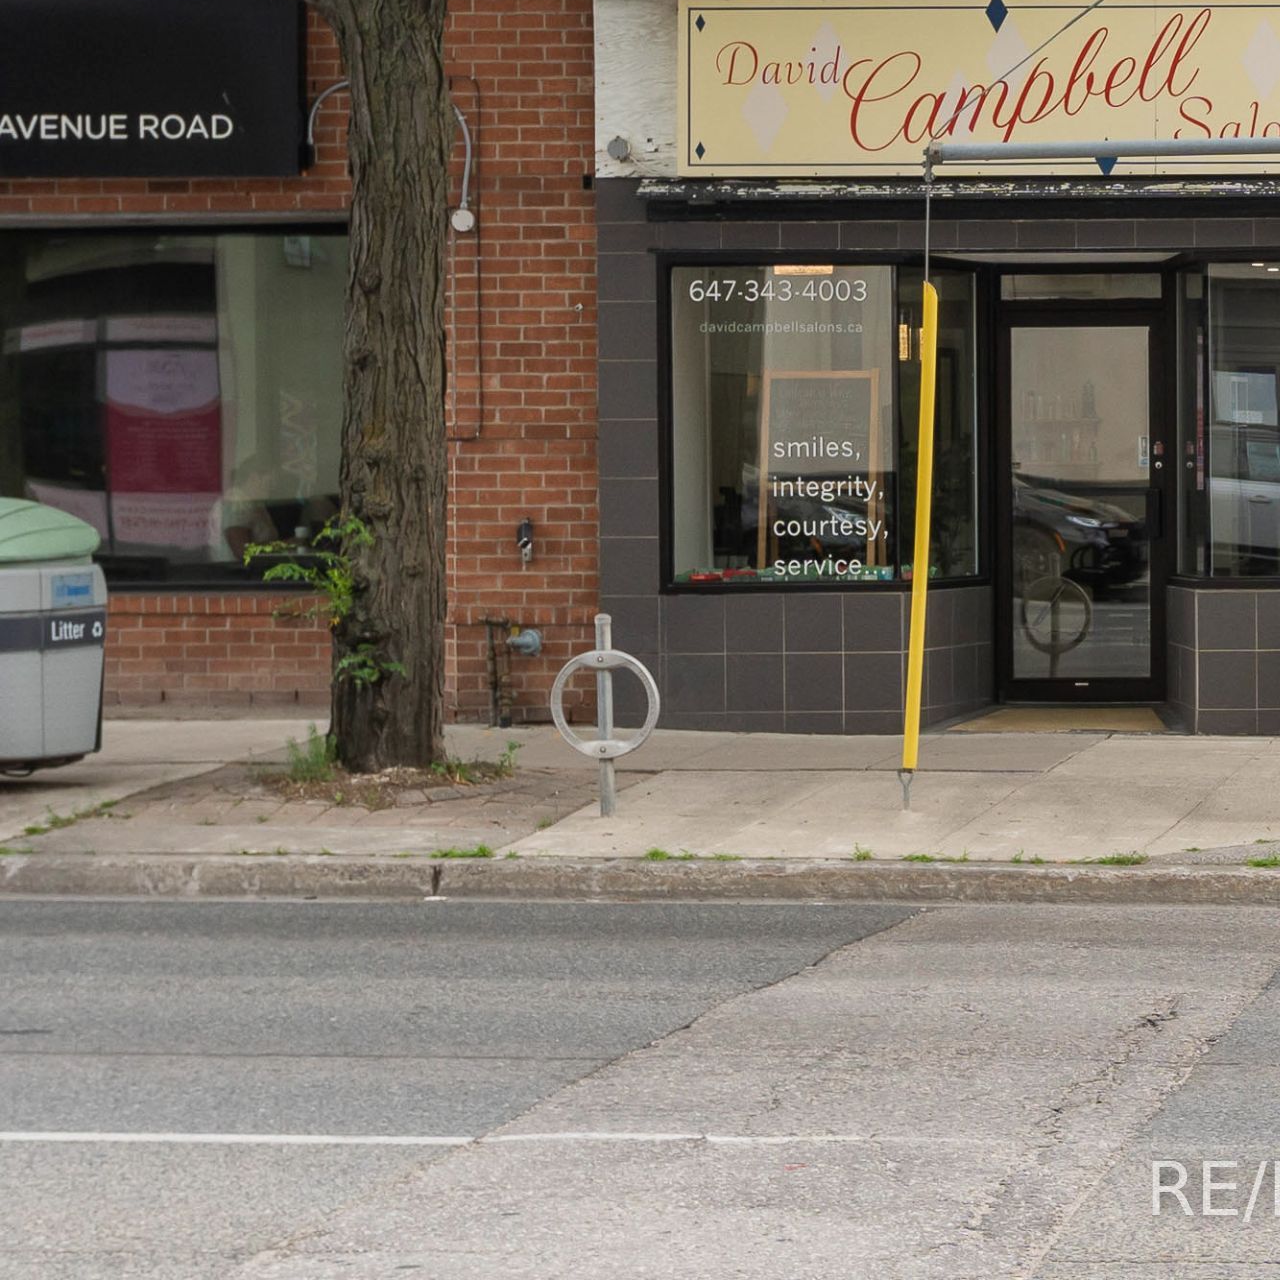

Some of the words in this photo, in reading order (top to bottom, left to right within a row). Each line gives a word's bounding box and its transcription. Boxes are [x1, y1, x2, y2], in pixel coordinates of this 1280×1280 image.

[716, 41, 843, 86] David
[843, 8, 1211, 152] Campbell
[0, 114, 128, 140] AVENUE
[139, 114, 234, 140] ROAD
[688, 280, 868, 302] 647-343-4003
[699, 321, 863, 335] davidcampbellsalons.ca
[773, 436, 861, 461] smiles,
[773, 476, 884, 501] integrity,
[773, 516, 888, 540] courtesy,
[773, 555, 886, 576] service...
[51, 620, 86, 641] Litter
